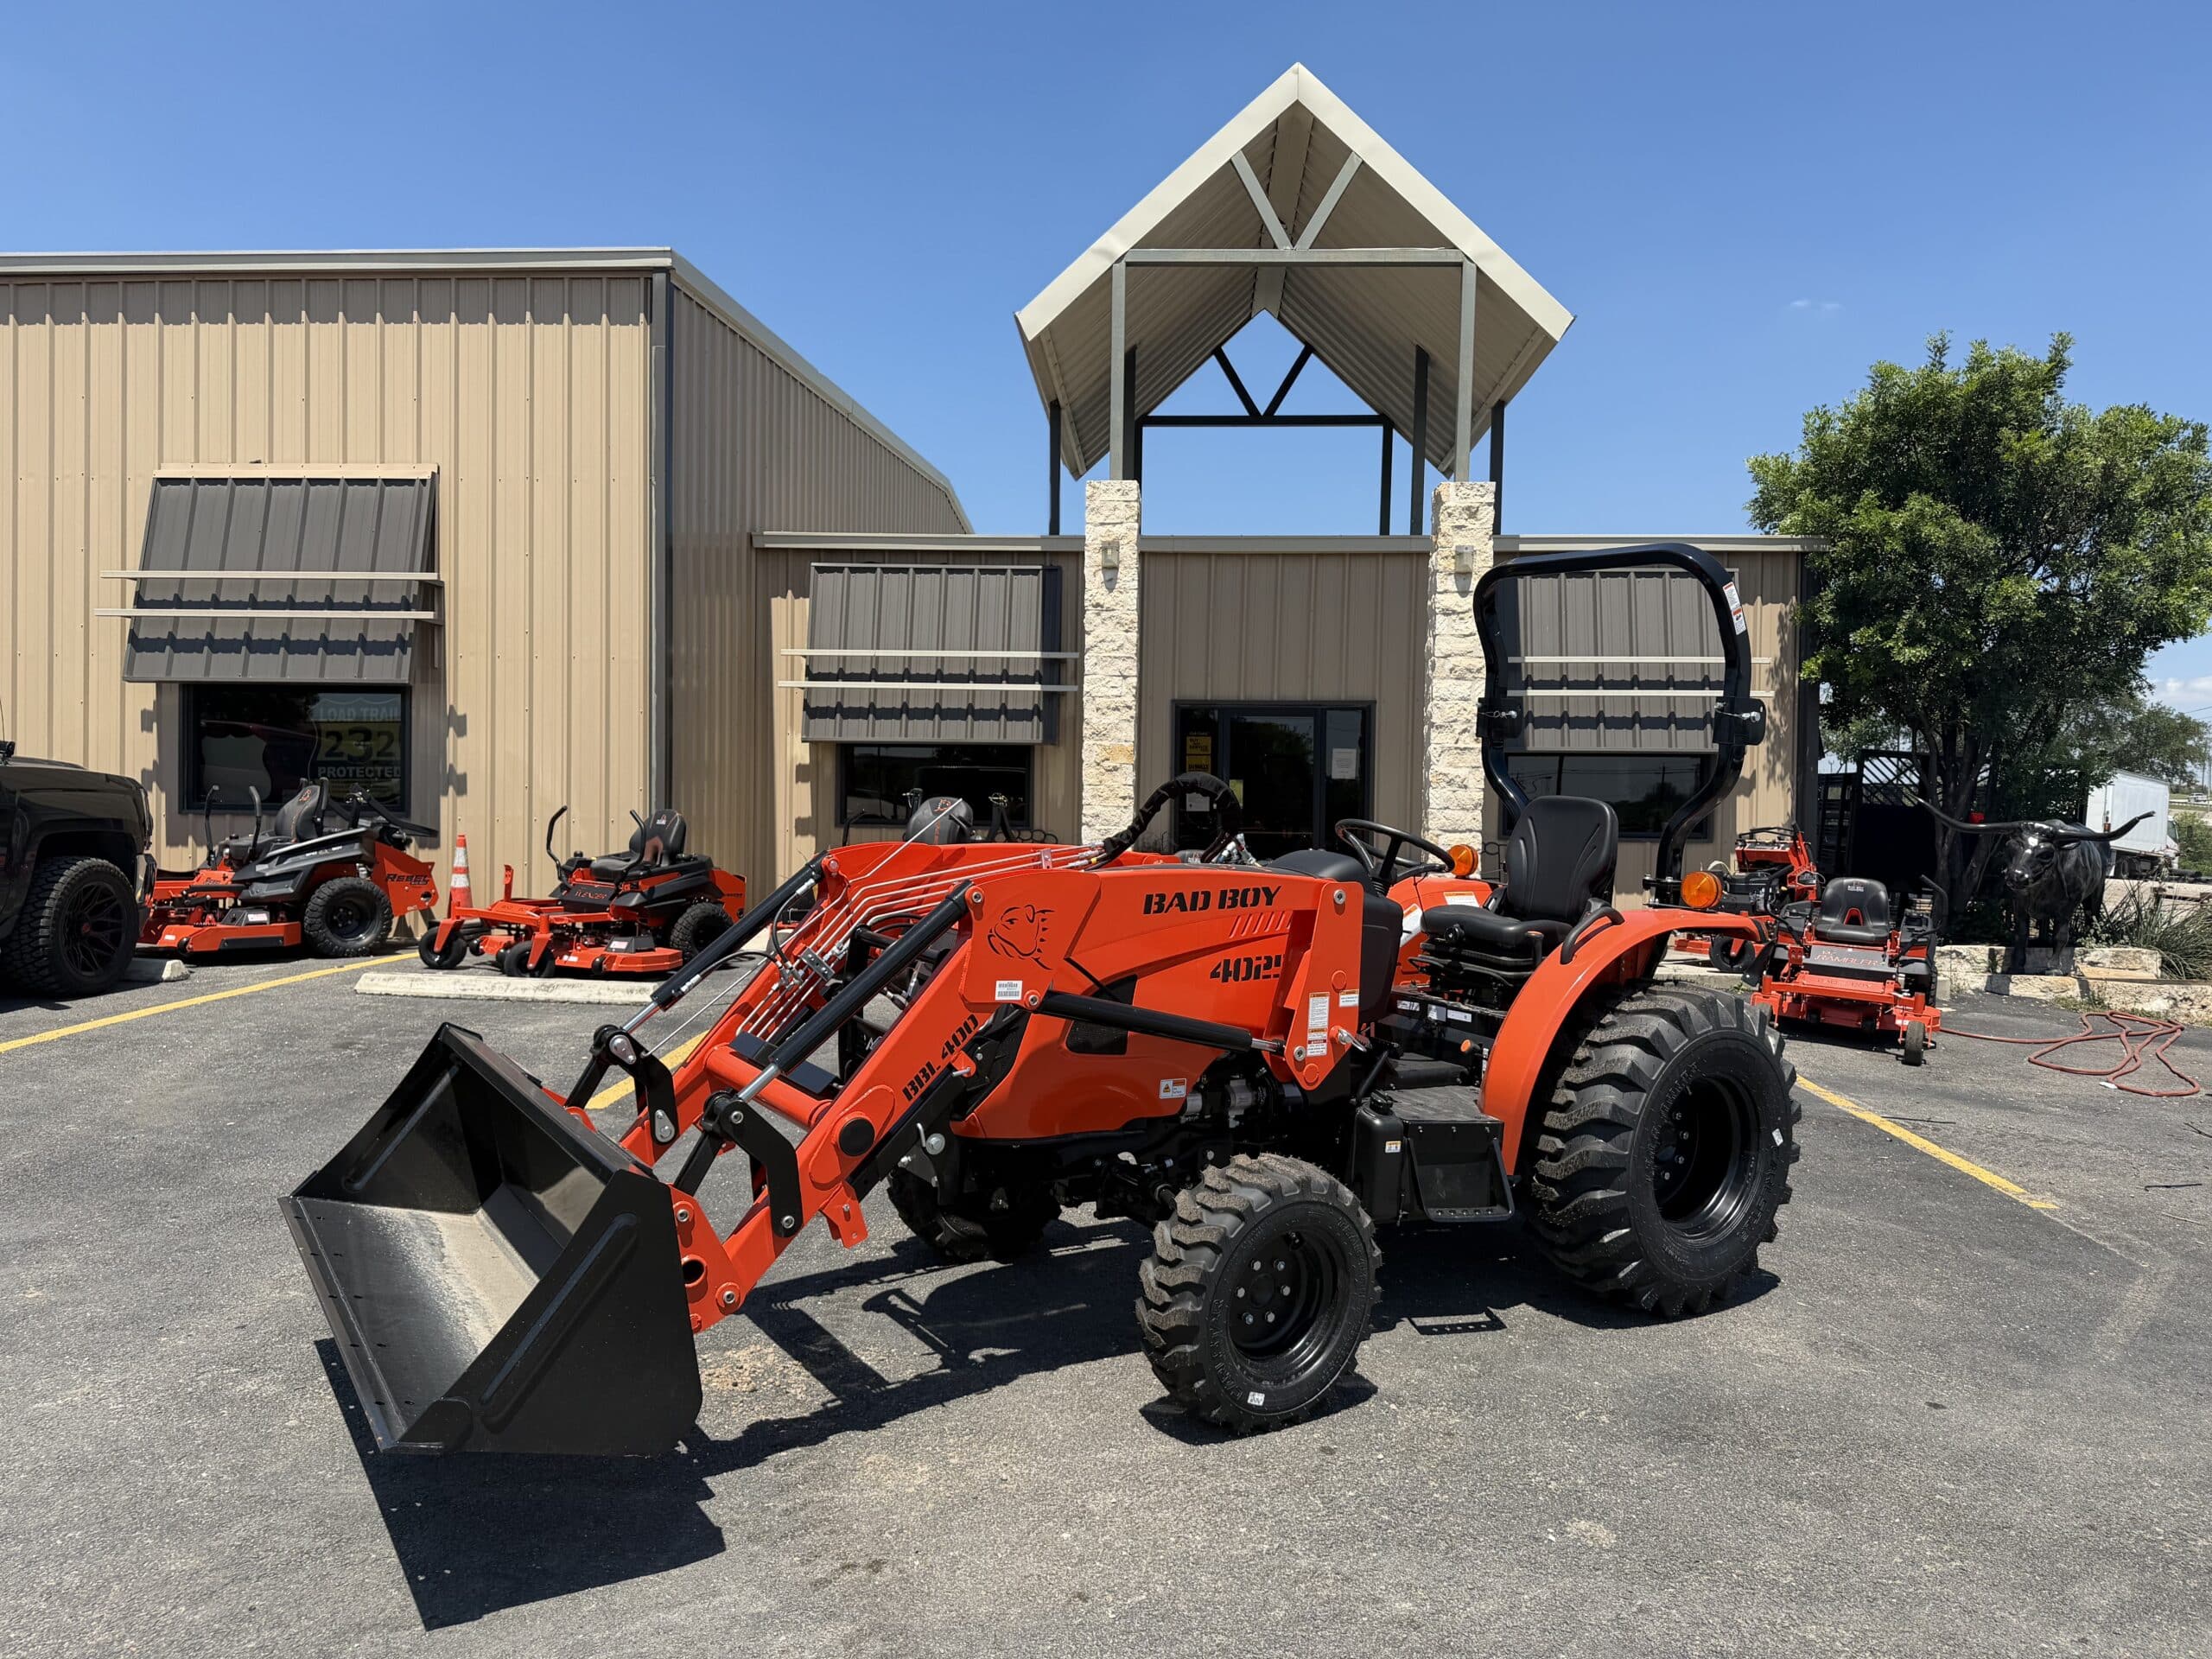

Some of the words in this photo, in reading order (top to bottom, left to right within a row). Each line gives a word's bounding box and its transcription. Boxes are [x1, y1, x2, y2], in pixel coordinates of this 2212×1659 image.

[320, 707, 356, 721] LOAD
[325, 727, 396, 762] 232
[318, 766, 401, 779] PROTECTED
[1143, 891, 1211, 915] BAD
[1217, 886, 1282, 910] BOY
[941, 1014, 980, 1060] 400
